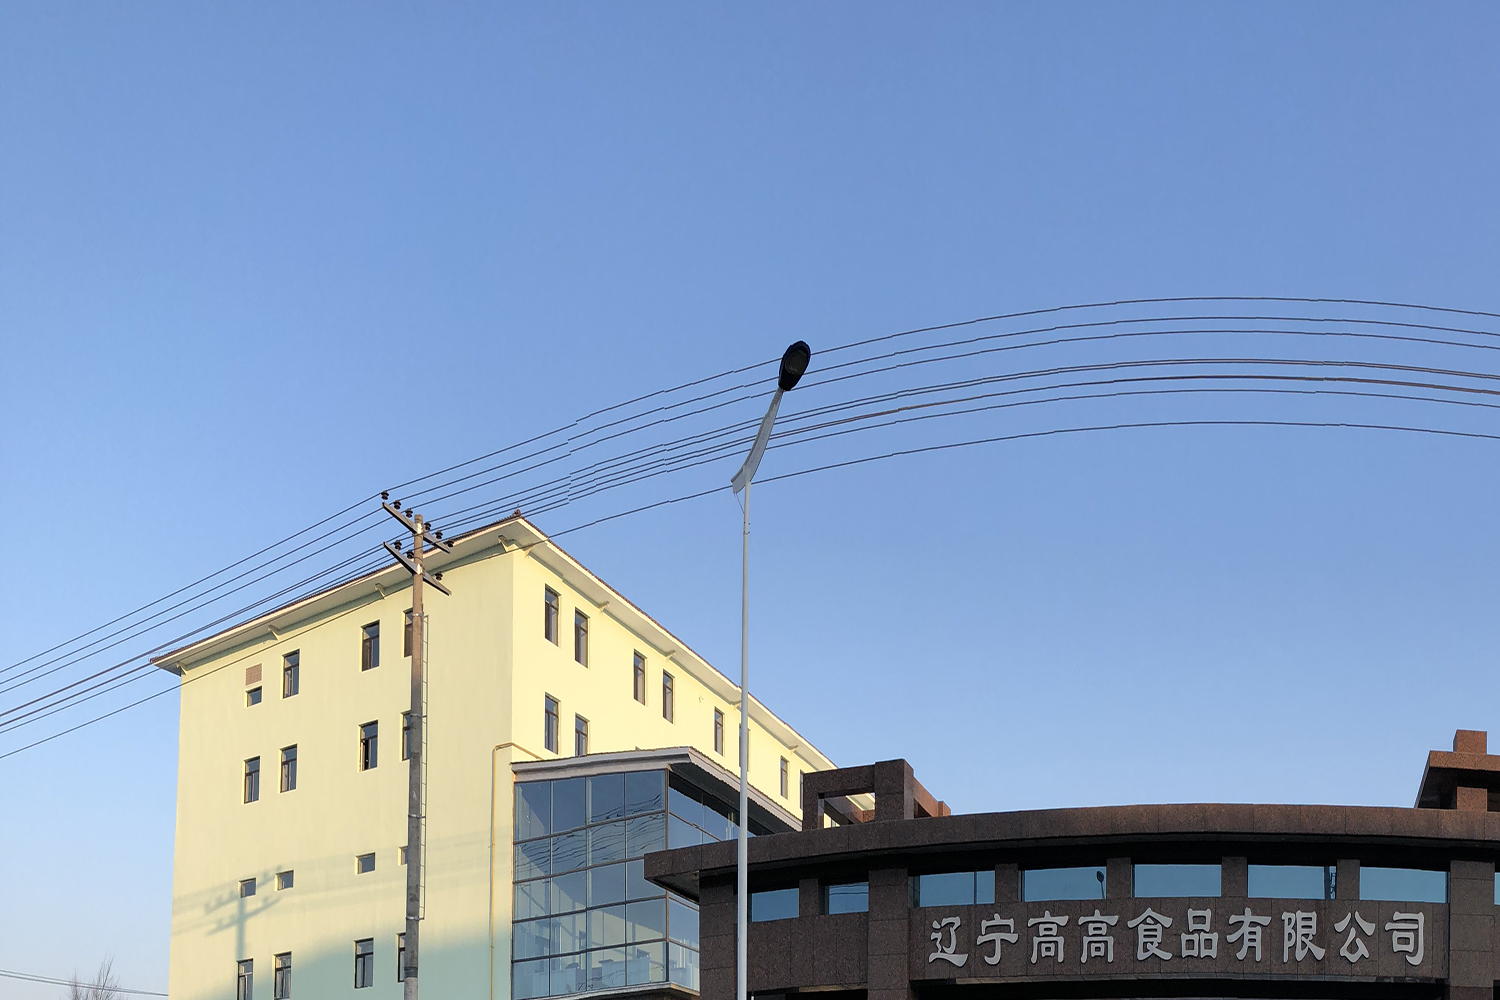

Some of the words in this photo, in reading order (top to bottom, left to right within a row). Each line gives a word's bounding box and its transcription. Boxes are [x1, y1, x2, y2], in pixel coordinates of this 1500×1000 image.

[928, 906, 1426, 966] 辽宁高高食品有限公司
